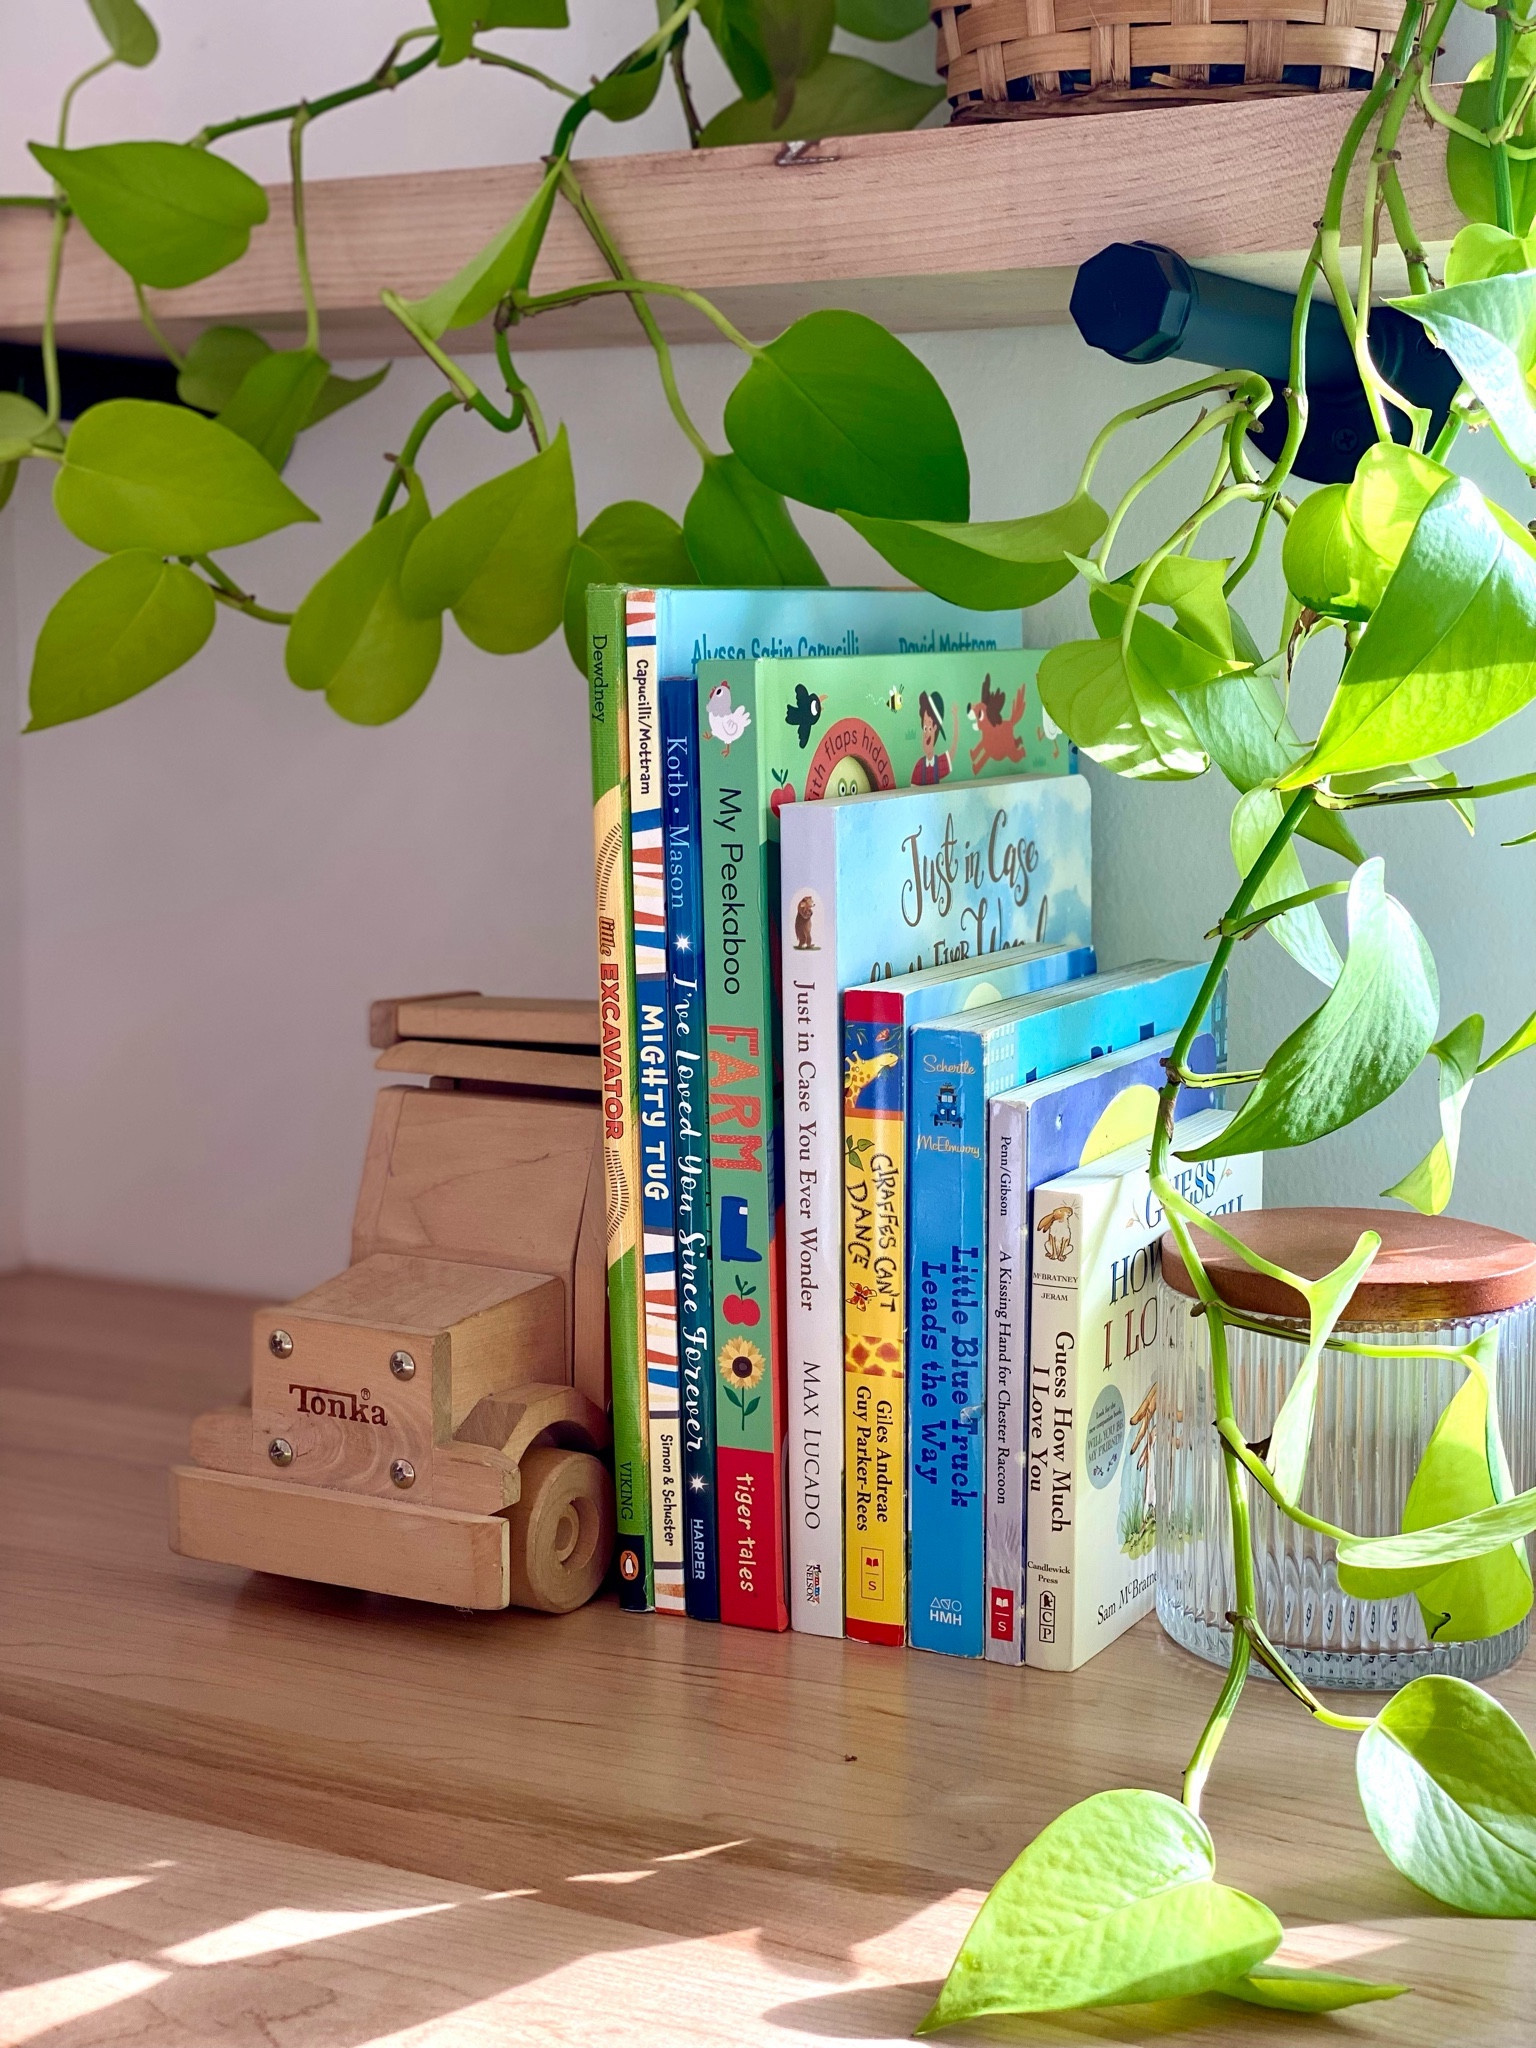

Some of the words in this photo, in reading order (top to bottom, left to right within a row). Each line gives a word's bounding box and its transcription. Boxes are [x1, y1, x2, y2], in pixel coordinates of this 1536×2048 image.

[592, 634, 608, 723] Dewdney
[633, 659, 653, 796] Capucilli/Mottram
[666, 736, 688, 797] Kotb
[808, 763, 826, 800] ith
[824, 729, 858, 760] flaps
[861, 727, 890, 788] hidde
[713, 787, 743, 832] My
[668, 824, 690, 909] Mason
[901, 813, 959, 928] Just
[964, 841, 985, 890] in
[987, 808, 1039, 907] Case
[720, 843, 747, 995] Peekaboo
[672, 973, 698, 1037] I've
[793, 980, 816, 1025] Just
[600, 963, 624, 1140] EXCAVATOR
[798, 1033, 815, 1052] in
[923, 1054, 976, 1075] Schertle
[675, 1050, 703, 1141] Loved
[708, 1024, 763, 1173] FARM
[797, 1060, 817, 1112] Case
[798, 1120, 818, 1154] You
[644, 1141, 670, 1201] TUG
[678, 1155, 704, 1216] You
[799, 1170, 818, 1219] Ever
[1000, 1136, 1012, 1217] Penn/Gibson
[1145, 1160, 1216, 1229] GESS
[846, 1179, 873, 1270] DANCE
[869, 1152, 900, 1250] GIRAFFES
[678, 1229, 707, 1314] Since
[800, 1226, 820, 1311] Wonder
[874, 1256, 900, 1313] CAN'T
[951, 1245, 979, 1324] Little
[1000, 1250, 1012, 1263] A
[921, 1261, 947, 1350] Leads
[994, 1268, 1012, 1320] Kissing
[1041, 1292, 1069, 1302] JERAM
[951, 1336, 979, 1406] Blue
[998, 1322, 1012, 1363] Hand
[1032, 1365, 1051, 1377] I
[1055, 1331, 1076, 1399] Guess
[1103, 1320, 1113, 1372] I
[683, 1326, 708, 1453] Forever
[803, 1360, 821, 1417] MAX
[853, 1384, 872, 1422] Guy
[921, 1362, 947, 1408] the
[998, 1367, 1011, 1385] for
[876, 1400, 893, 1443] Giles
[998, 1390, 1012, 1444] Chester
[1032, 1384, 1050, 1439] Love
[1053, 1407, 1073, 1462] How
[1103, 1424, 1115, 1440] YOU
[660, 1434, 673, 1473] Simon
[663, 1476, 675, 1485] &
[803, 1428, 822, 1530] LUCADO
[856, 1429, 873, 1531] Parker-Rees
[915, 1420, 947, 1485] Way
[951, 1416, 979, 1508] Truck
[997, 1446, 1011, 1505] Raccoon
[1030, 1447, 1049, 1492] You
[620, 1461, 634, 1521] VIKING
[734, 1473, 755, 1530] tiger
[876, 1449, 893, 1524] Andreae
[1051, 1468, 1072, 1534] Much
[662, 1490, 676, 1546] Schuster
[693, 1519, 706, 1580] HARPER
[737, 1537, 757, 1592] tales
[1027, 1560, 1071, 1575] Candlewick
[806, 1564, 816, 1603] NELSON
[868, 1580, 877, 1591] S
[1038, 1574, 1059, 1585] Press
[1097, 1604, 1116, 1625] Sam
[1119, 1571, 1158, 1609] McBratne
[930, 1609, 962, 1627] HMH
[998, 1621, 1007, 1632] S
[1042, 1611, 1052, 1623] C
[1042, 1628, 1052, 1639] P
